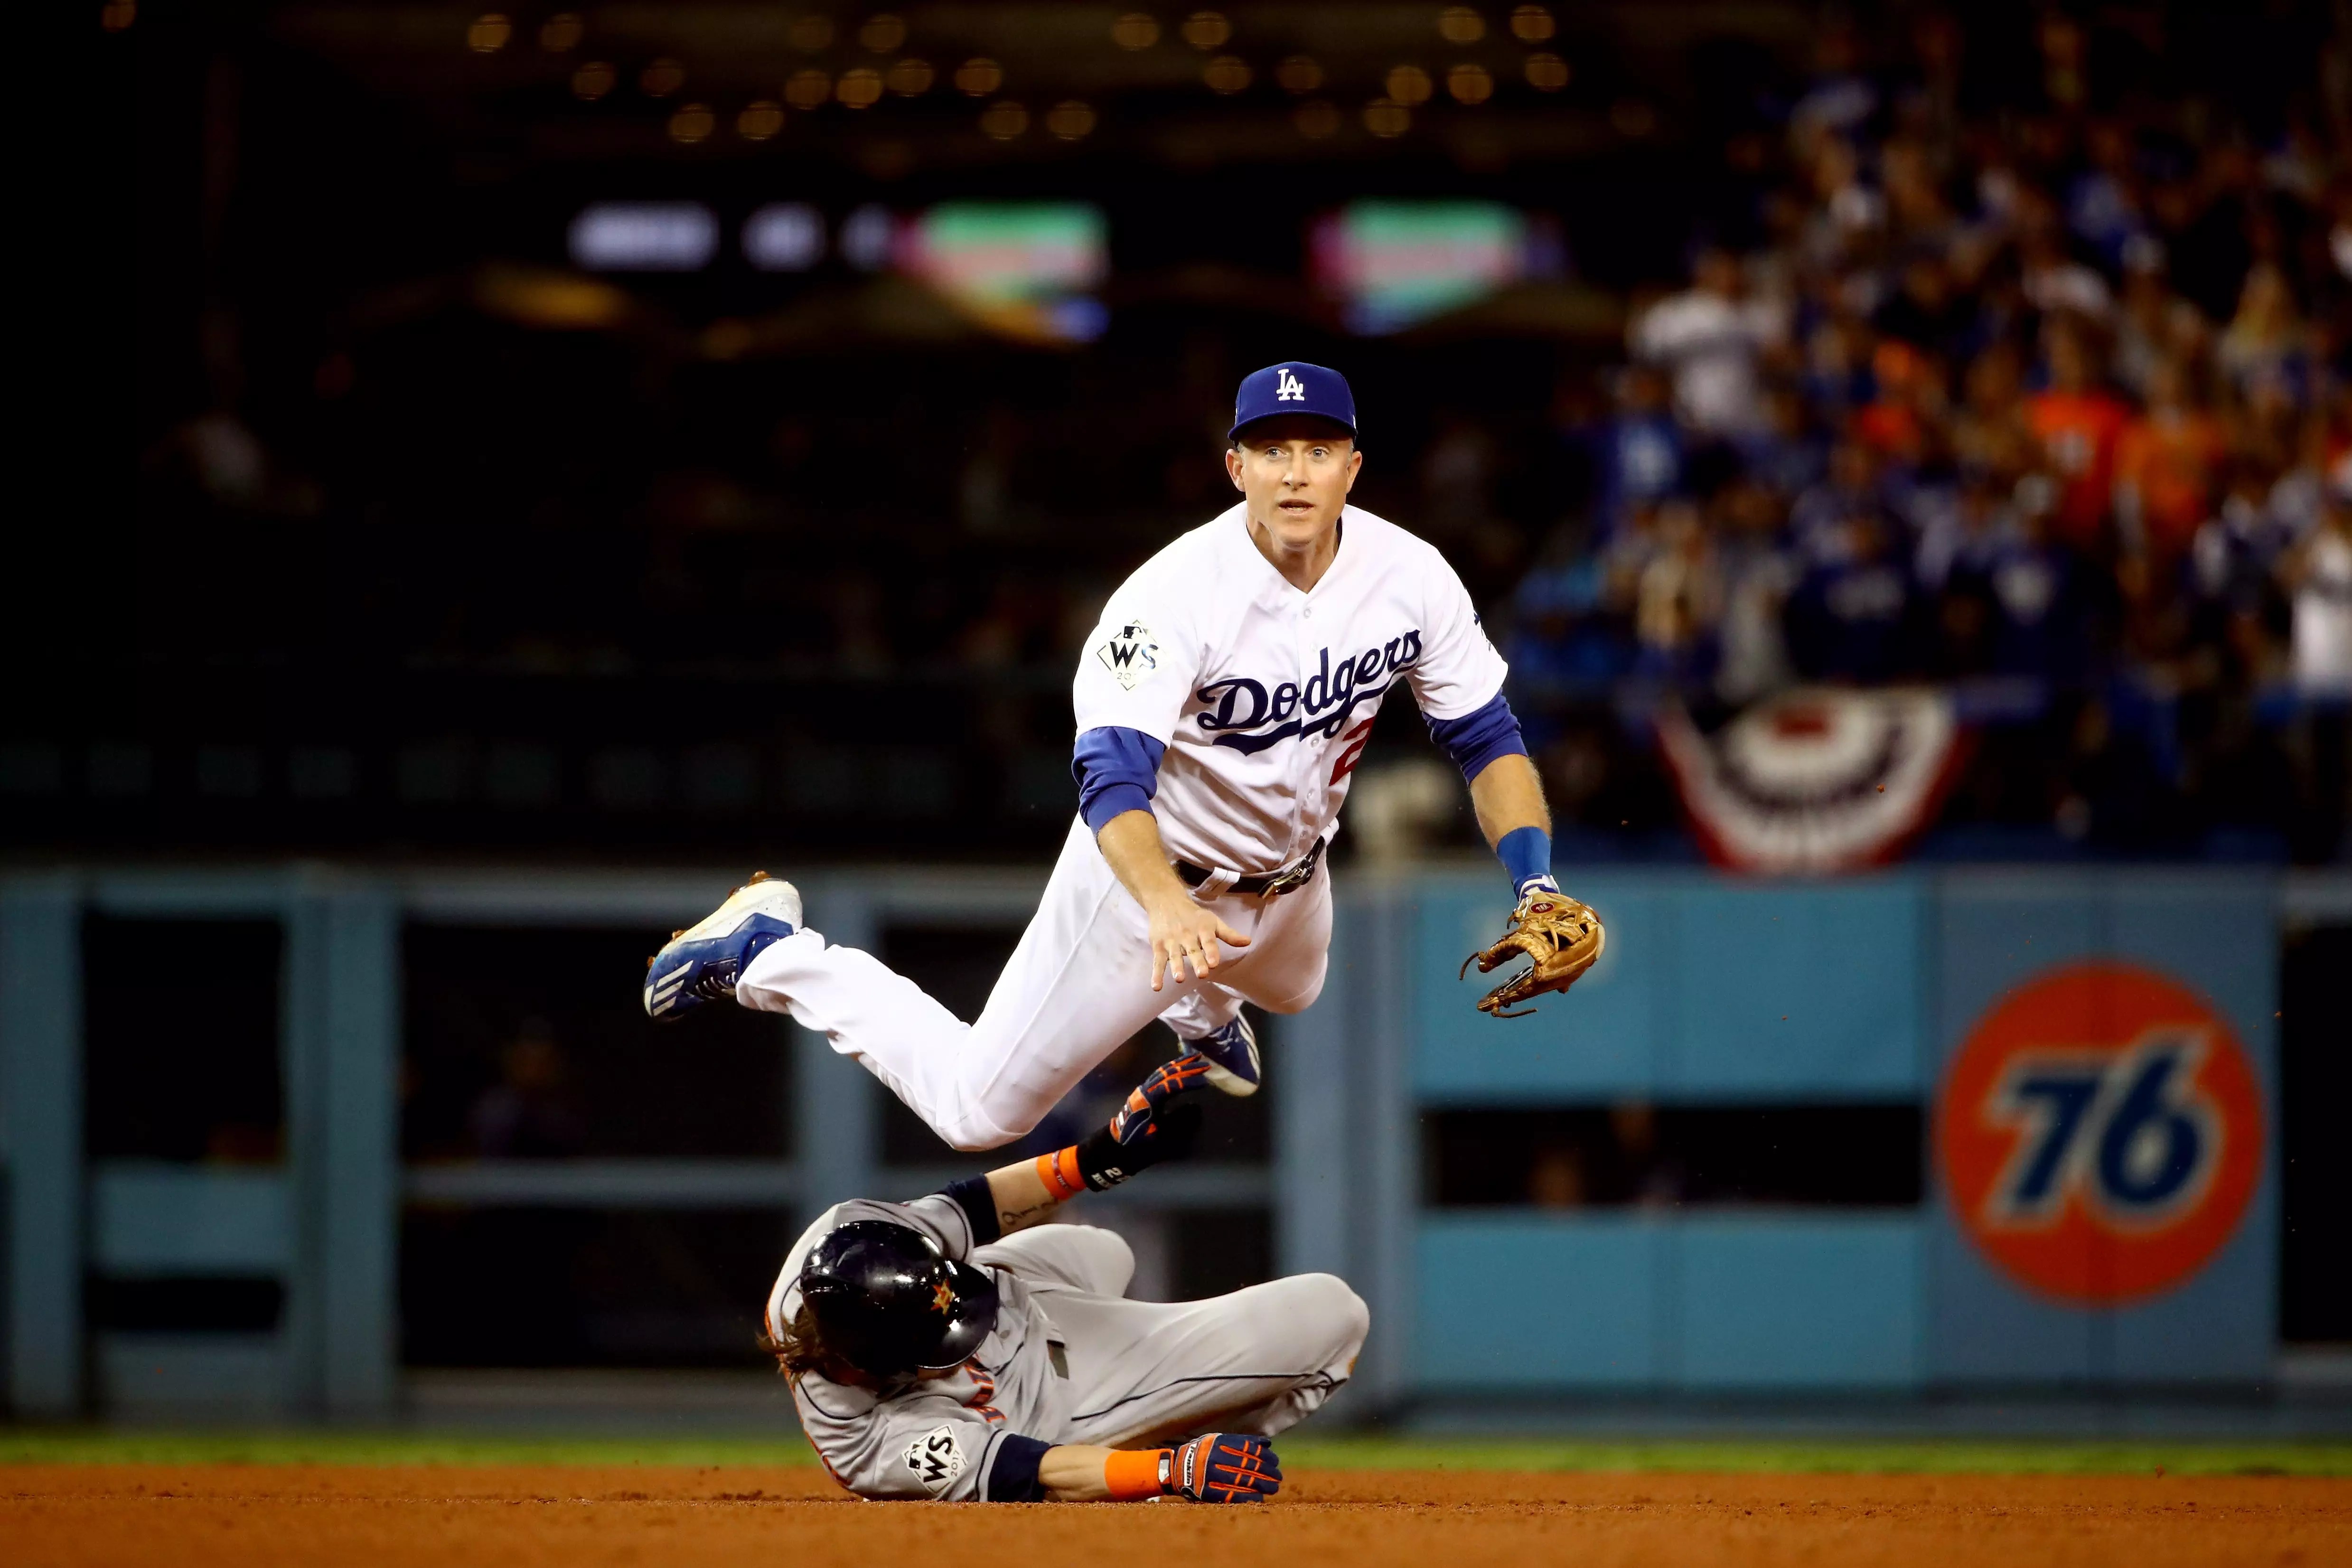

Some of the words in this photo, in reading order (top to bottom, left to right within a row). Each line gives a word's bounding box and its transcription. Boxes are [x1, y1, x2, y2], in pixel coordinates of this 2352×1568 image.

[1276, 368, 1305, 401] LA
[1110, 641, 1159, 669] WS
[1197, 629, 1423, 740] Dodgers
[1987, 1028, 2224, 1232] 76
[924, 1436, 954, 1483] WS
[950, 1449, 960, 1477] 2017
